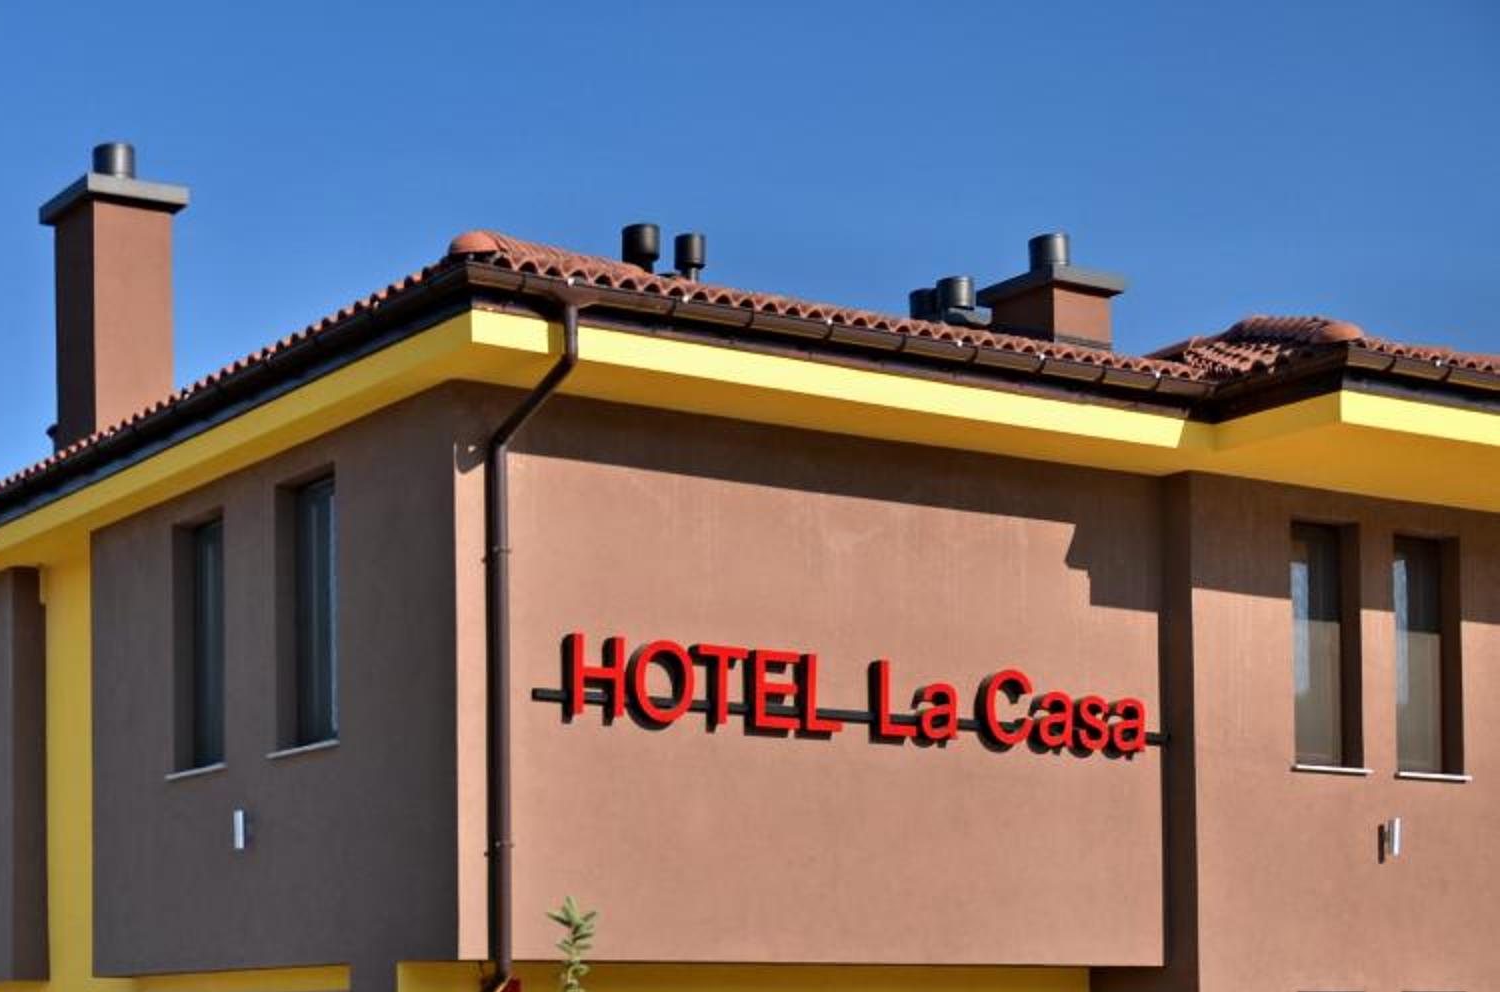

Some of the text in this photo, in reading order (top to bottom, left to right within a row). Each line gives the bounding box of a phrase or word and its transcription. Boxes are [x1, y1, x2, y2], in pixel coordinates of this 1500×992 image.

[565, 632, 1149, 754] HOTEL La Casa
